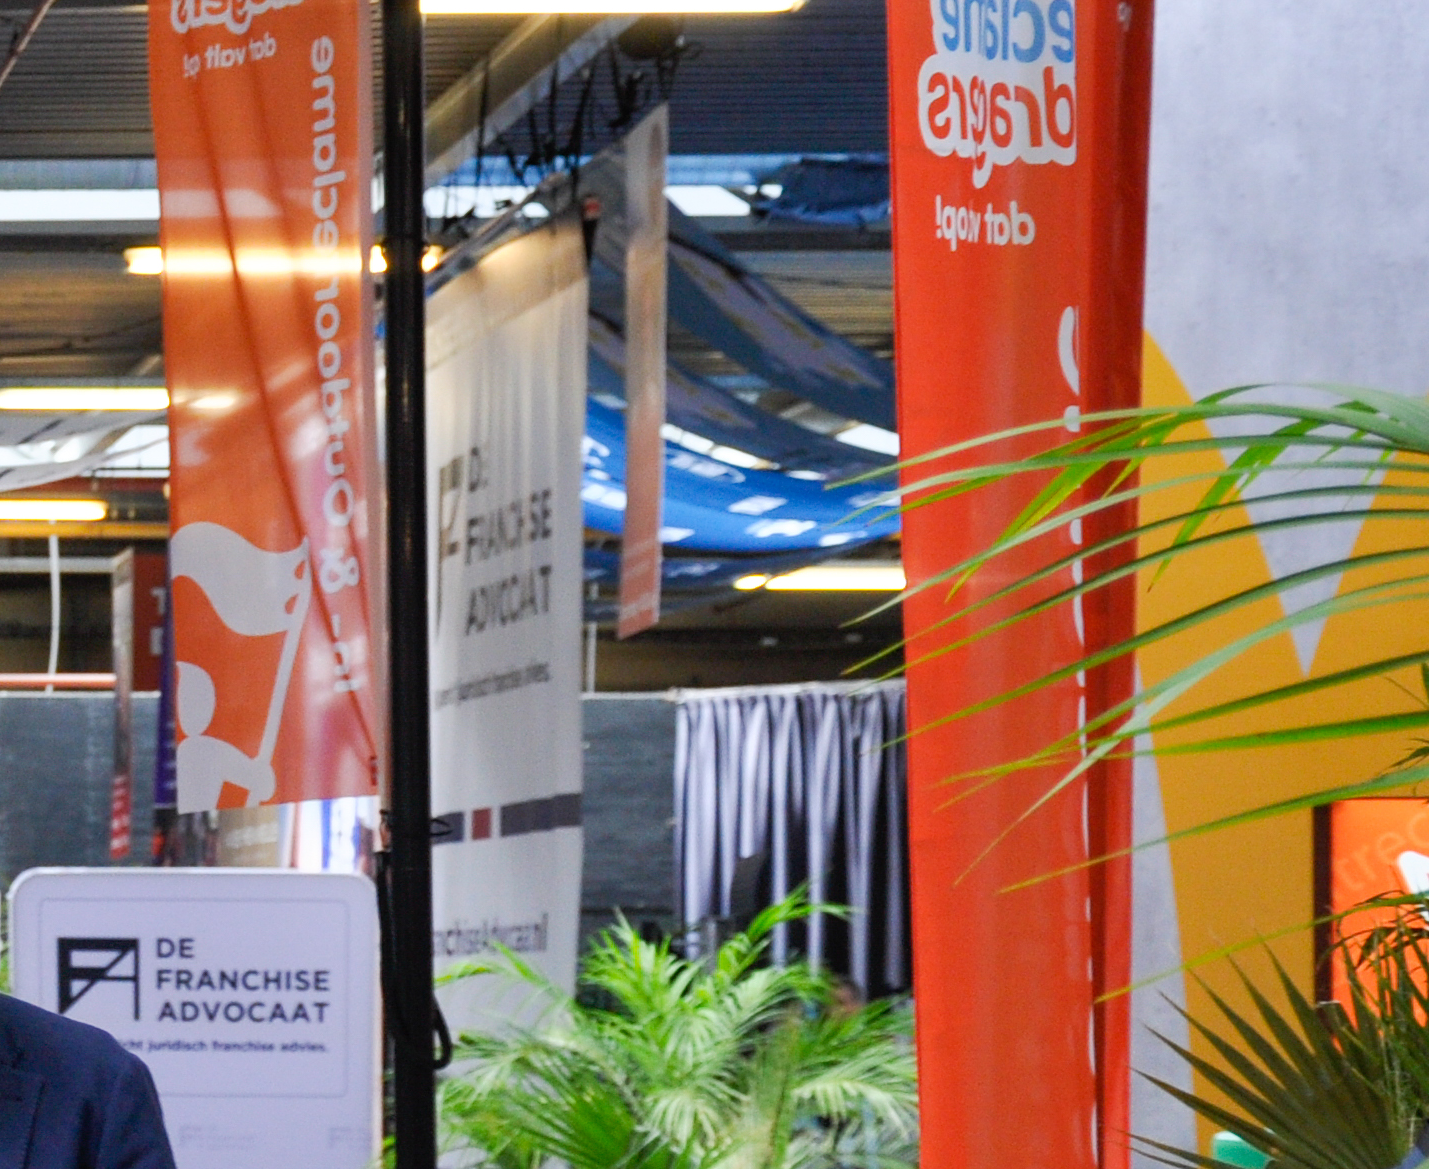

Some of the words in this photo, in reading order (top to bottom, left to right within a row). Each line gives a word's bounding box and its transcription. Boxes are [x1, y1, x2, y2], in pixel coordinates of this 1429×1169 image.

[156, 938, 195, 959] DE
[156, 969, 331, 992] FRANCHISE
[158, 1001, 331, 1024] ADVOCAAT
[147, 1039, 207, 1053] juridisch
[211, 1039, 275, 1051] franchise
